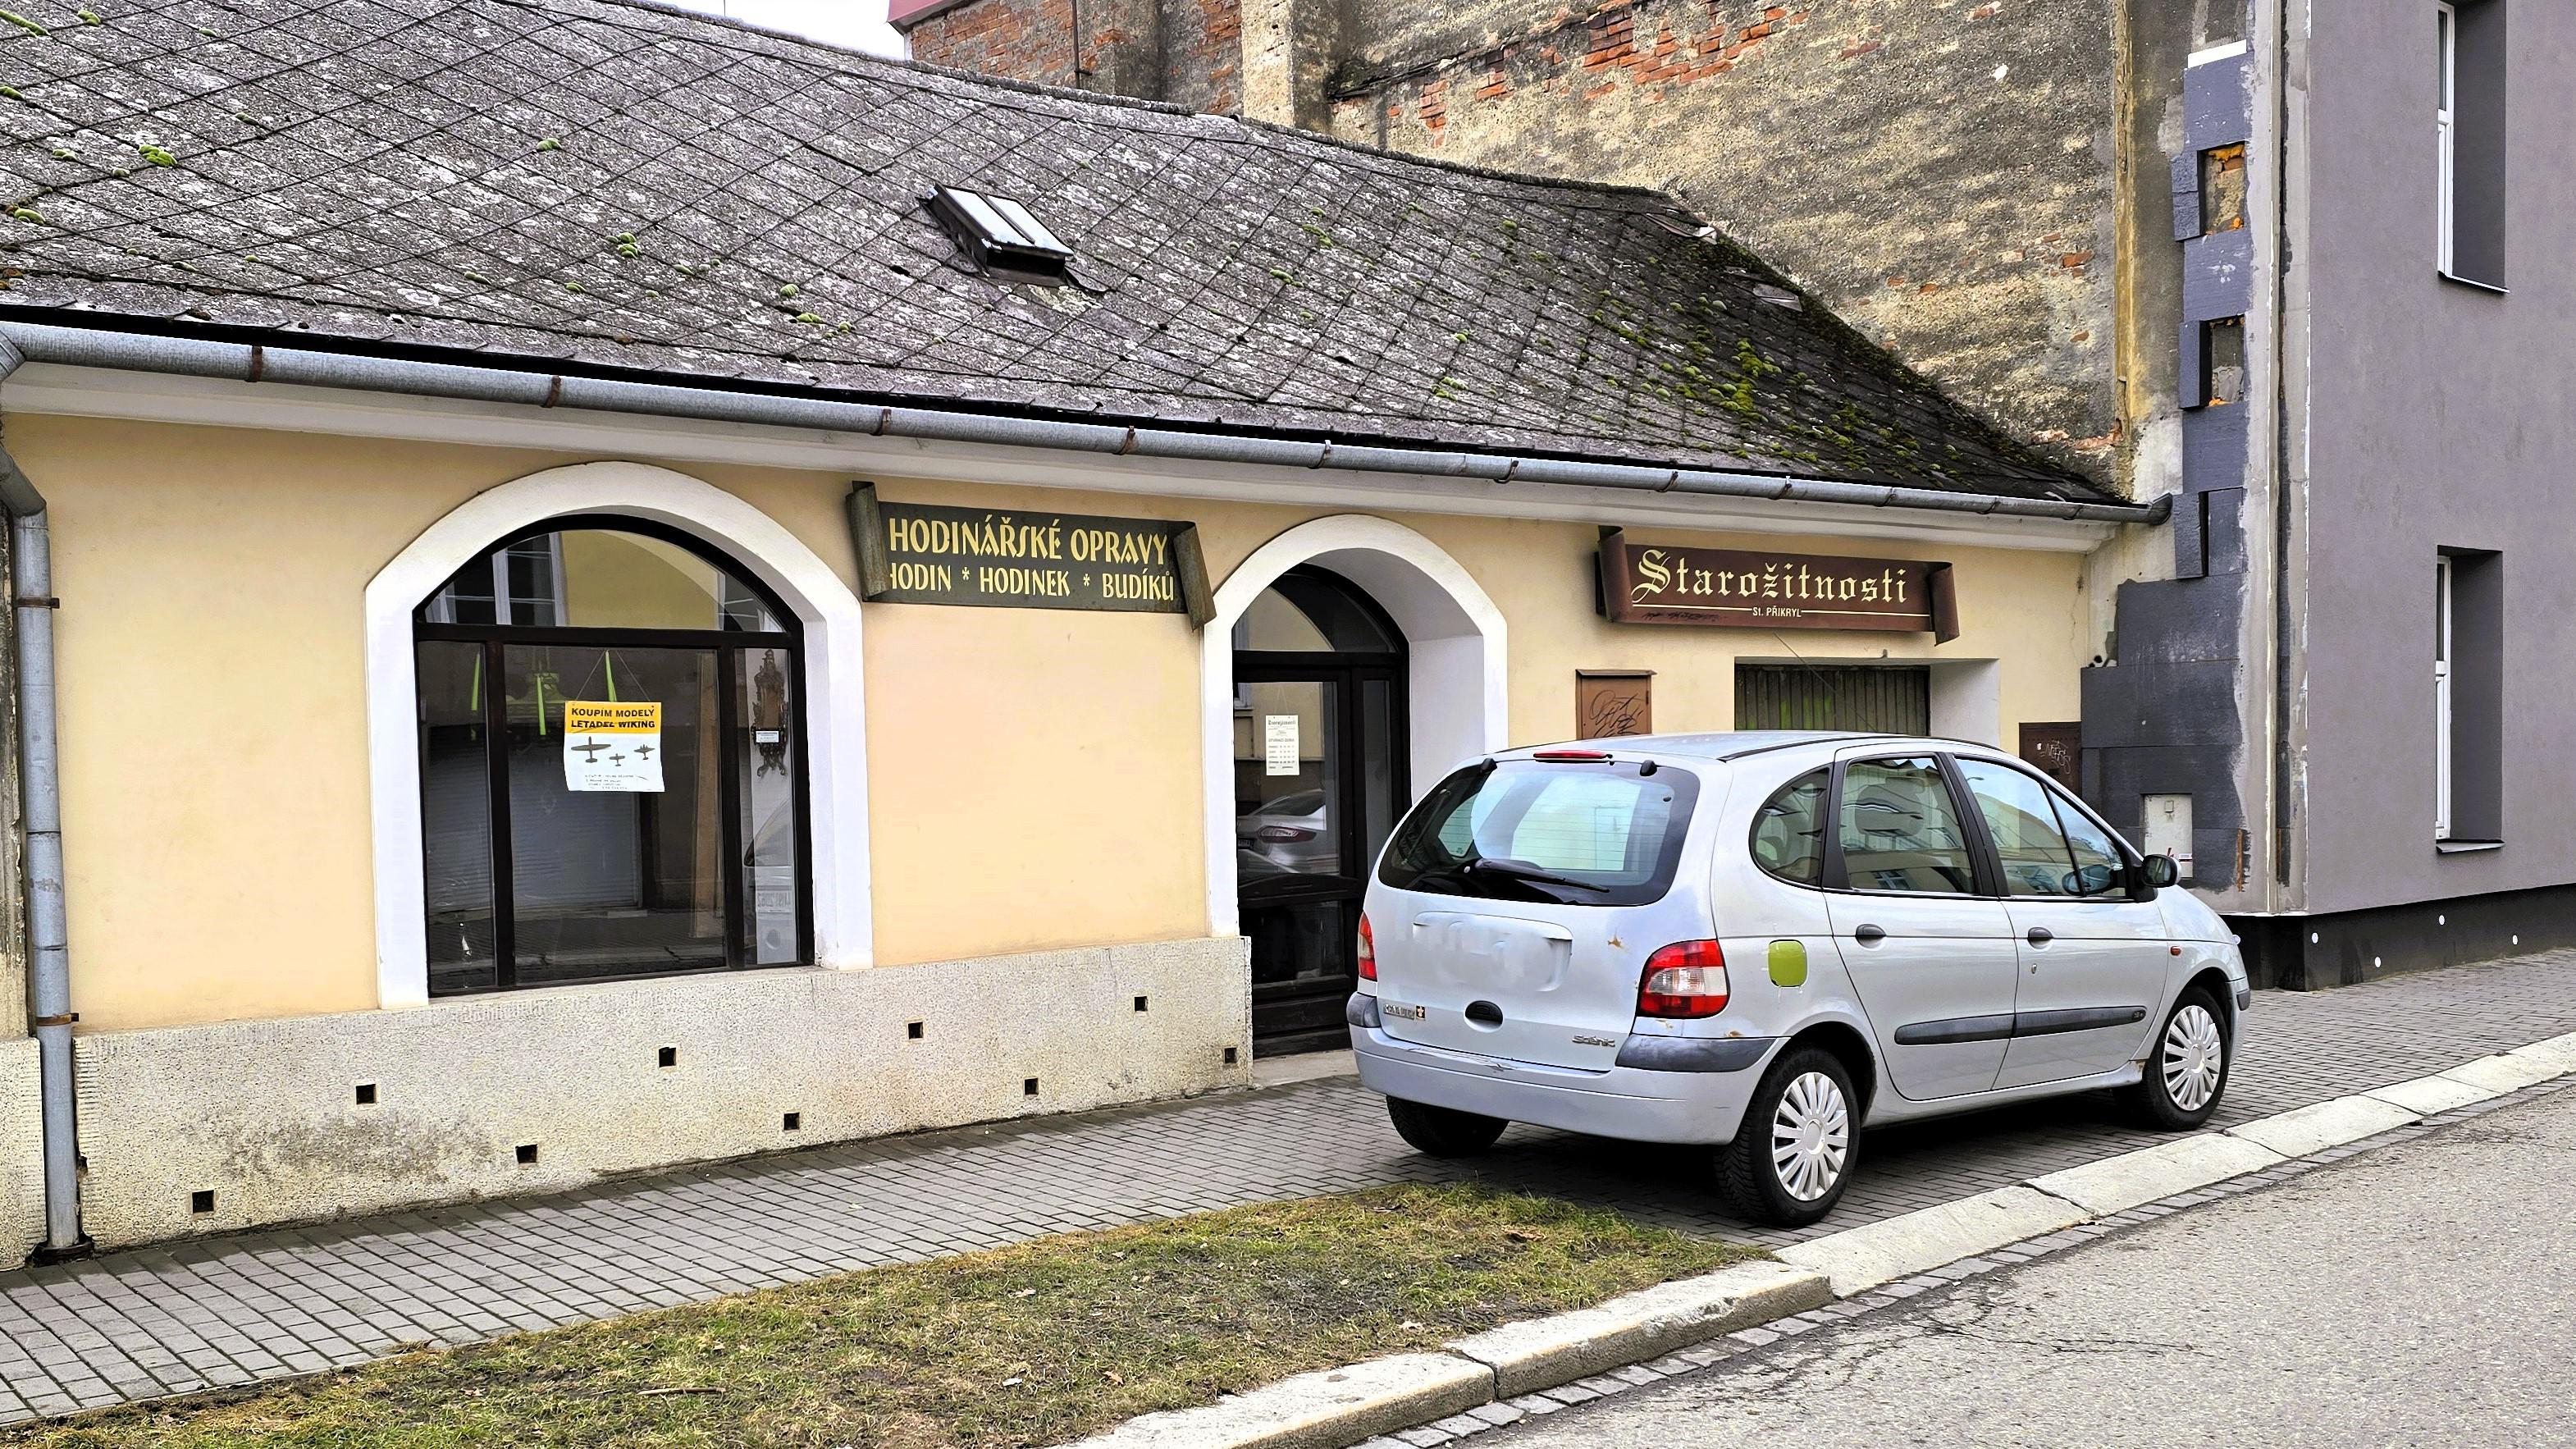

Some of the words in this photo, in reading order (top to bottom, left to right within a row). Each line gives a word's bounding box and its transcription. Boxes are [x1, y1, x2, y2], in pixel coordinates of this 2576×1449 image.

[889, 514, 1062, 560] HODINÁŘSKÉ
[1071, 528, 1167, 565] OPRAVY
[980, 567, 1071, 597] HODINEK
[1102, 569, 1175, 601] BUDÍKŮ
[1631, 549, 1907, 604] Starožitnosti
[1765, 605, 1802, 618] PŘIKRYL
[615, 709, 655, 717] MODELY
[618, 720, 655, 729] WIKING
